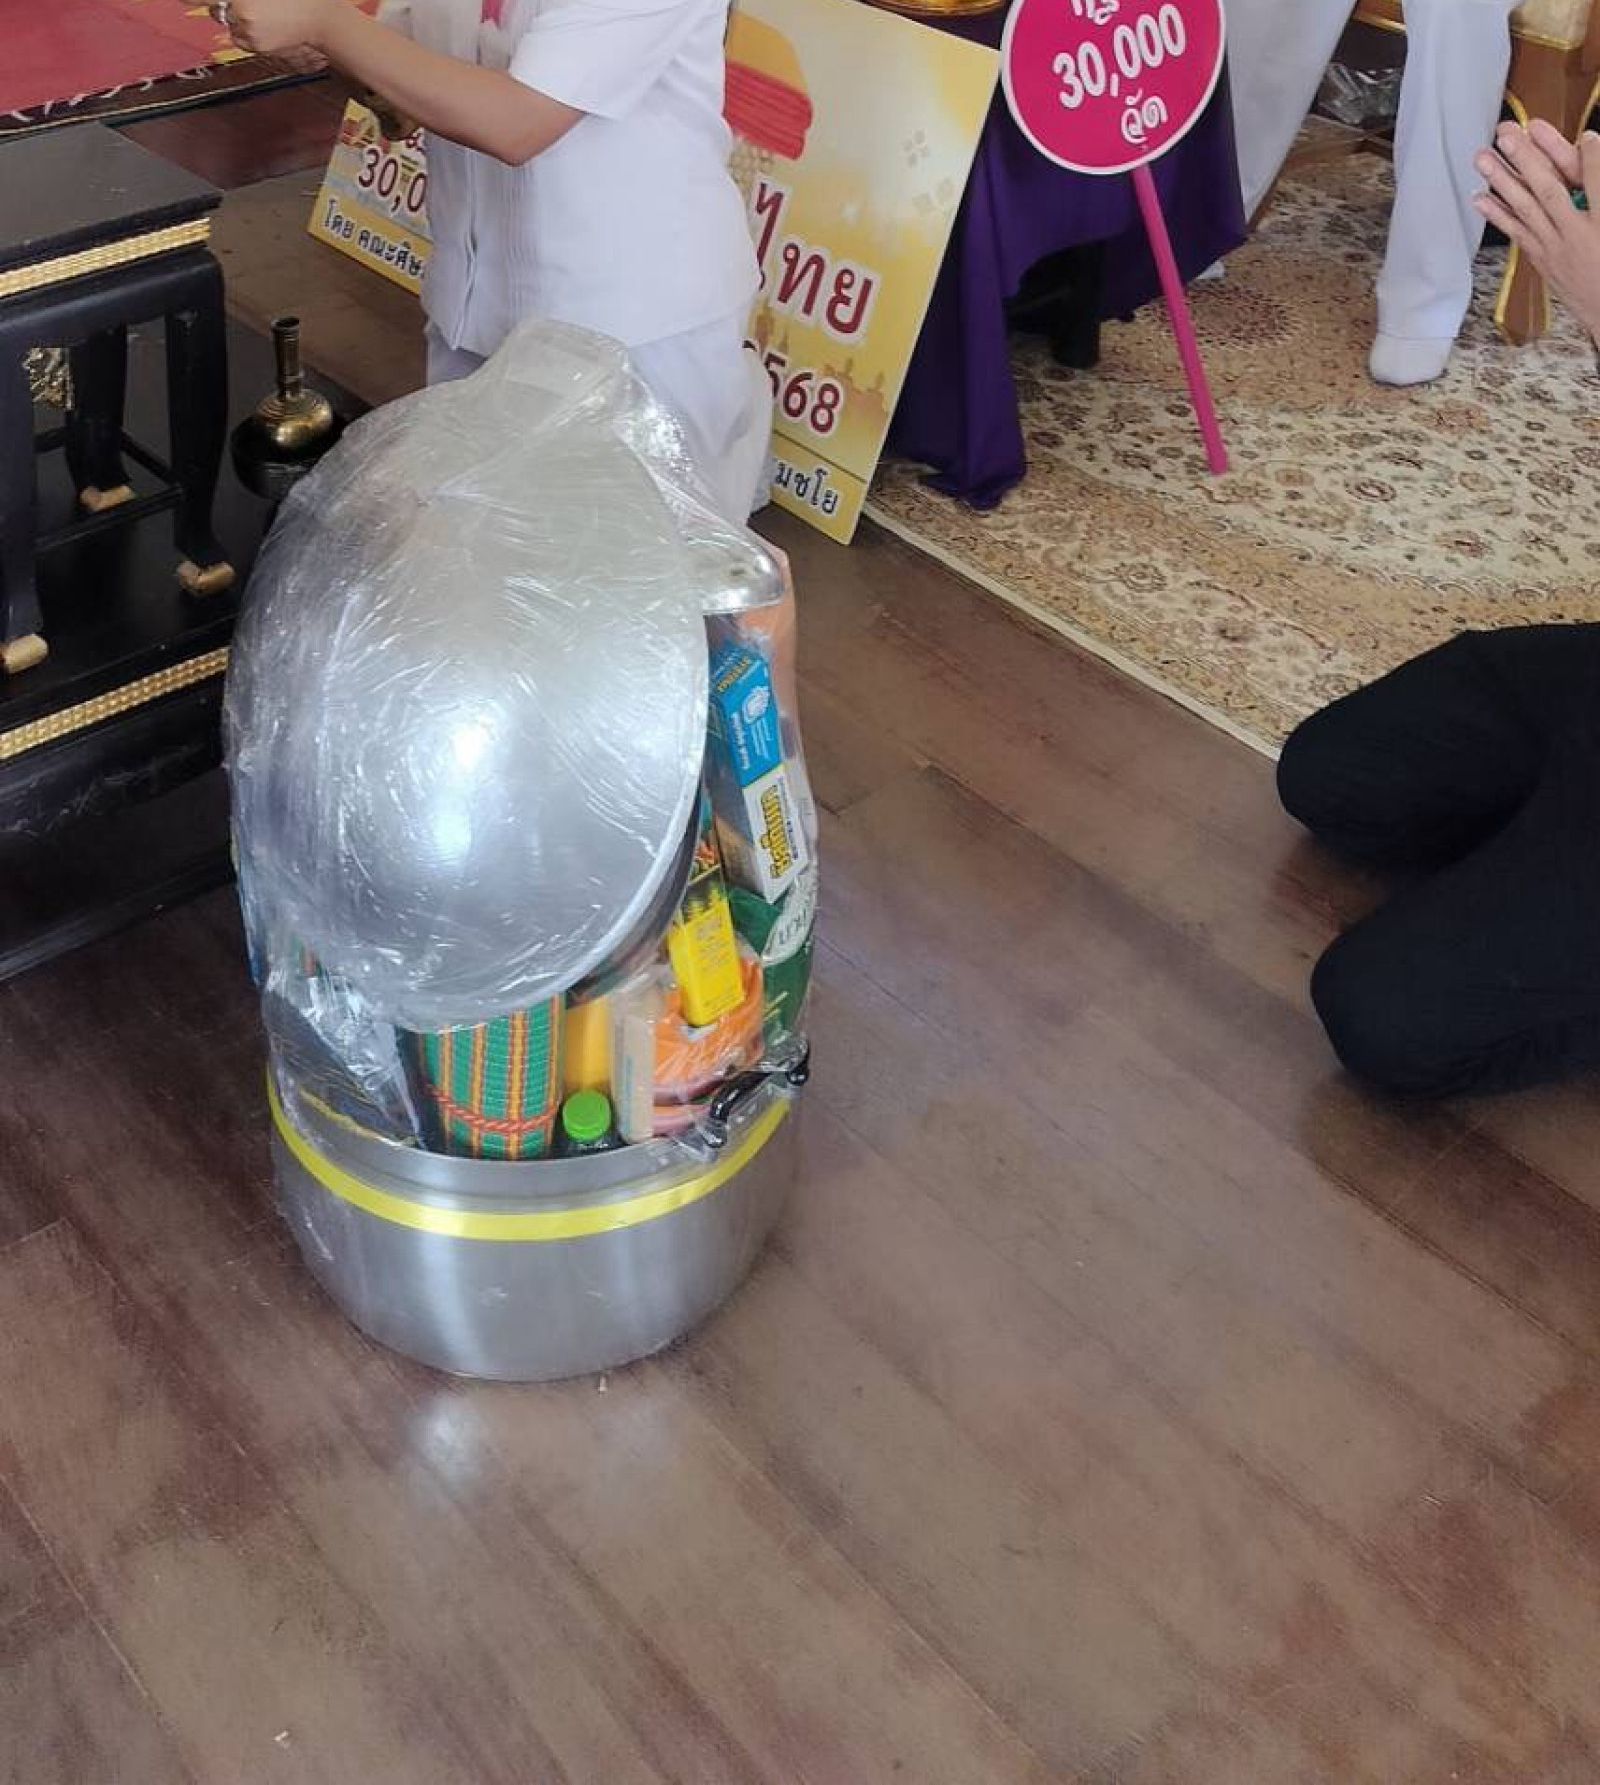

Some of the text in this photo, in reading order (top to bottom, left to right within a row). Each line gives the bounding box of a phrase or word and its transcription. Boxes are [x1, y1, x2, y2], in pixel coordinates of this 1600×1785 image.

[1053, 4, 1187, 109] 30,000
[357, 228, 425, 280] คณะศิษ
[742, 339, 841, 435] 568
